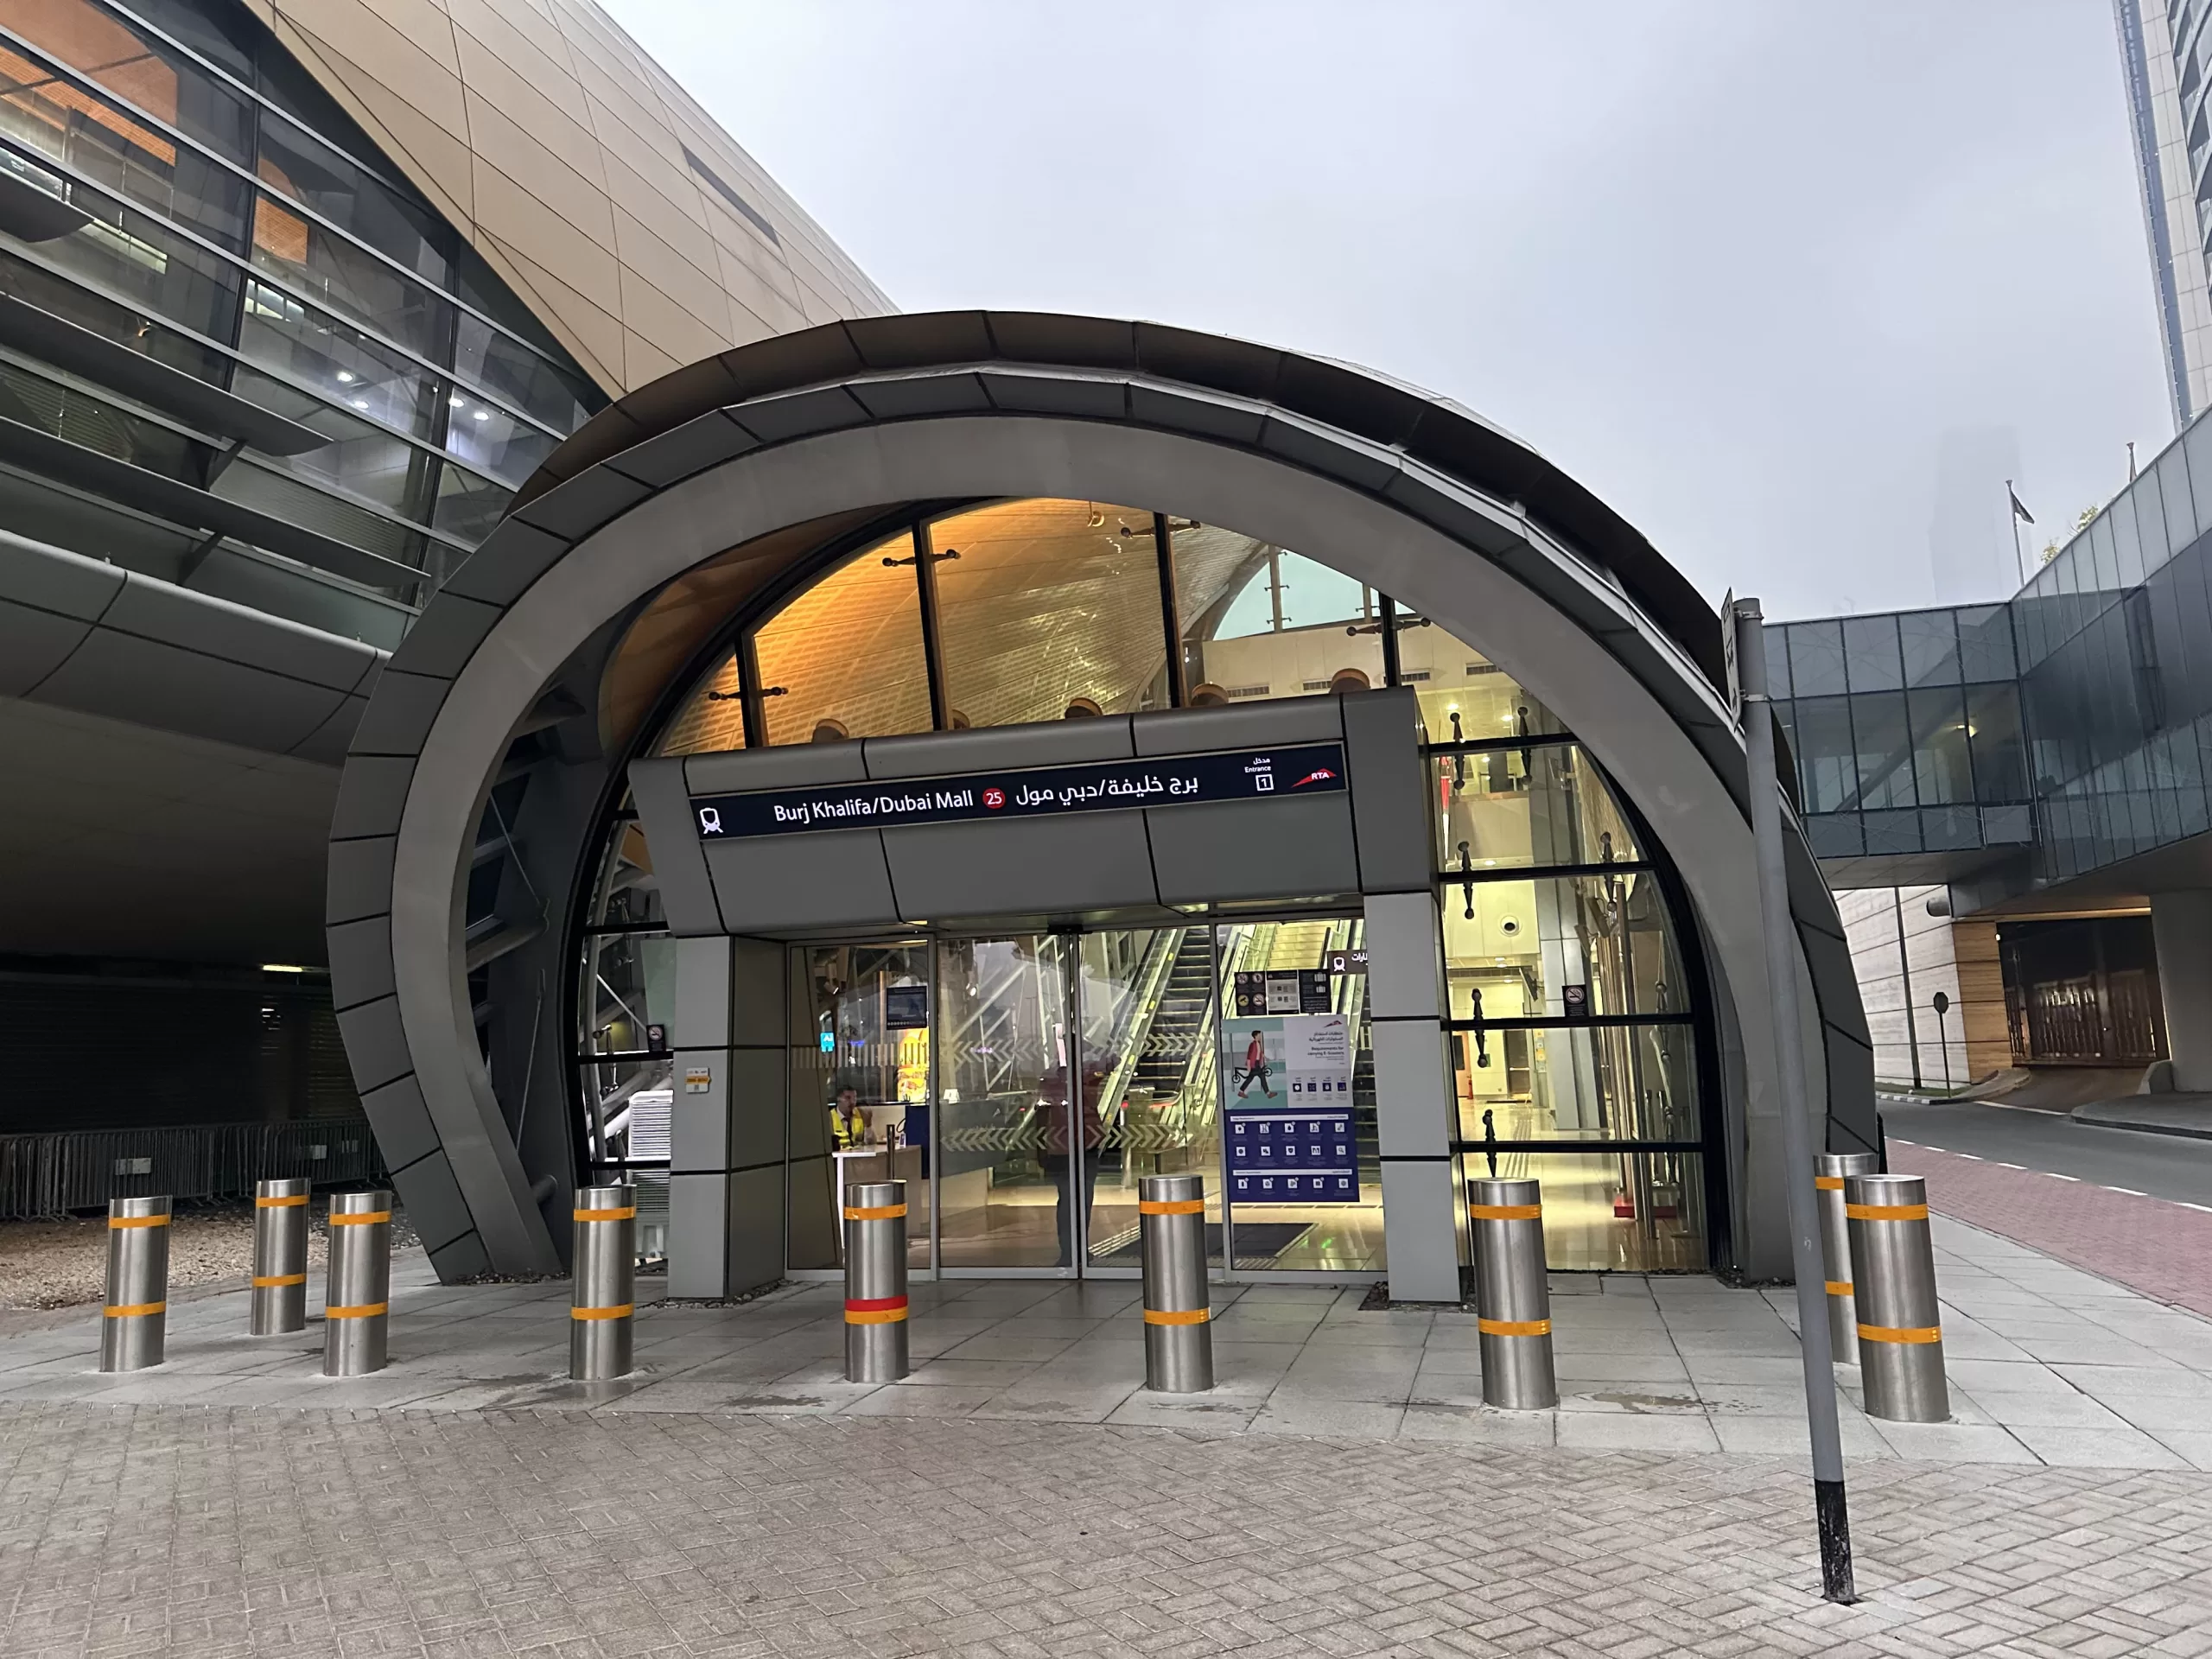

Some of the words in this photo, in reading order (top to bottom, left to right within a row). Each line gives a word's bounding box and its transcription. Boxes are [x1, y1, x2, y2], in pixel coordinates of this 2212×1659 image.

[1252, 757, 1271, 766] مدخل
[1261, 778, 1268, 788] 1
[1311, 772, 1330, 780] RTA
[1058, 775, 1165, 807] خليفة/دبي
[1169, 777, 1199, 795] برج
[985, 791, 1002, 805] 25
[1015, 785, 1054, 807] مول
[773, 803, 810, 824] Burj
[812, 793, 932, 819] Khalifa/Dubai
[936, 790, 974, 810] Mall
